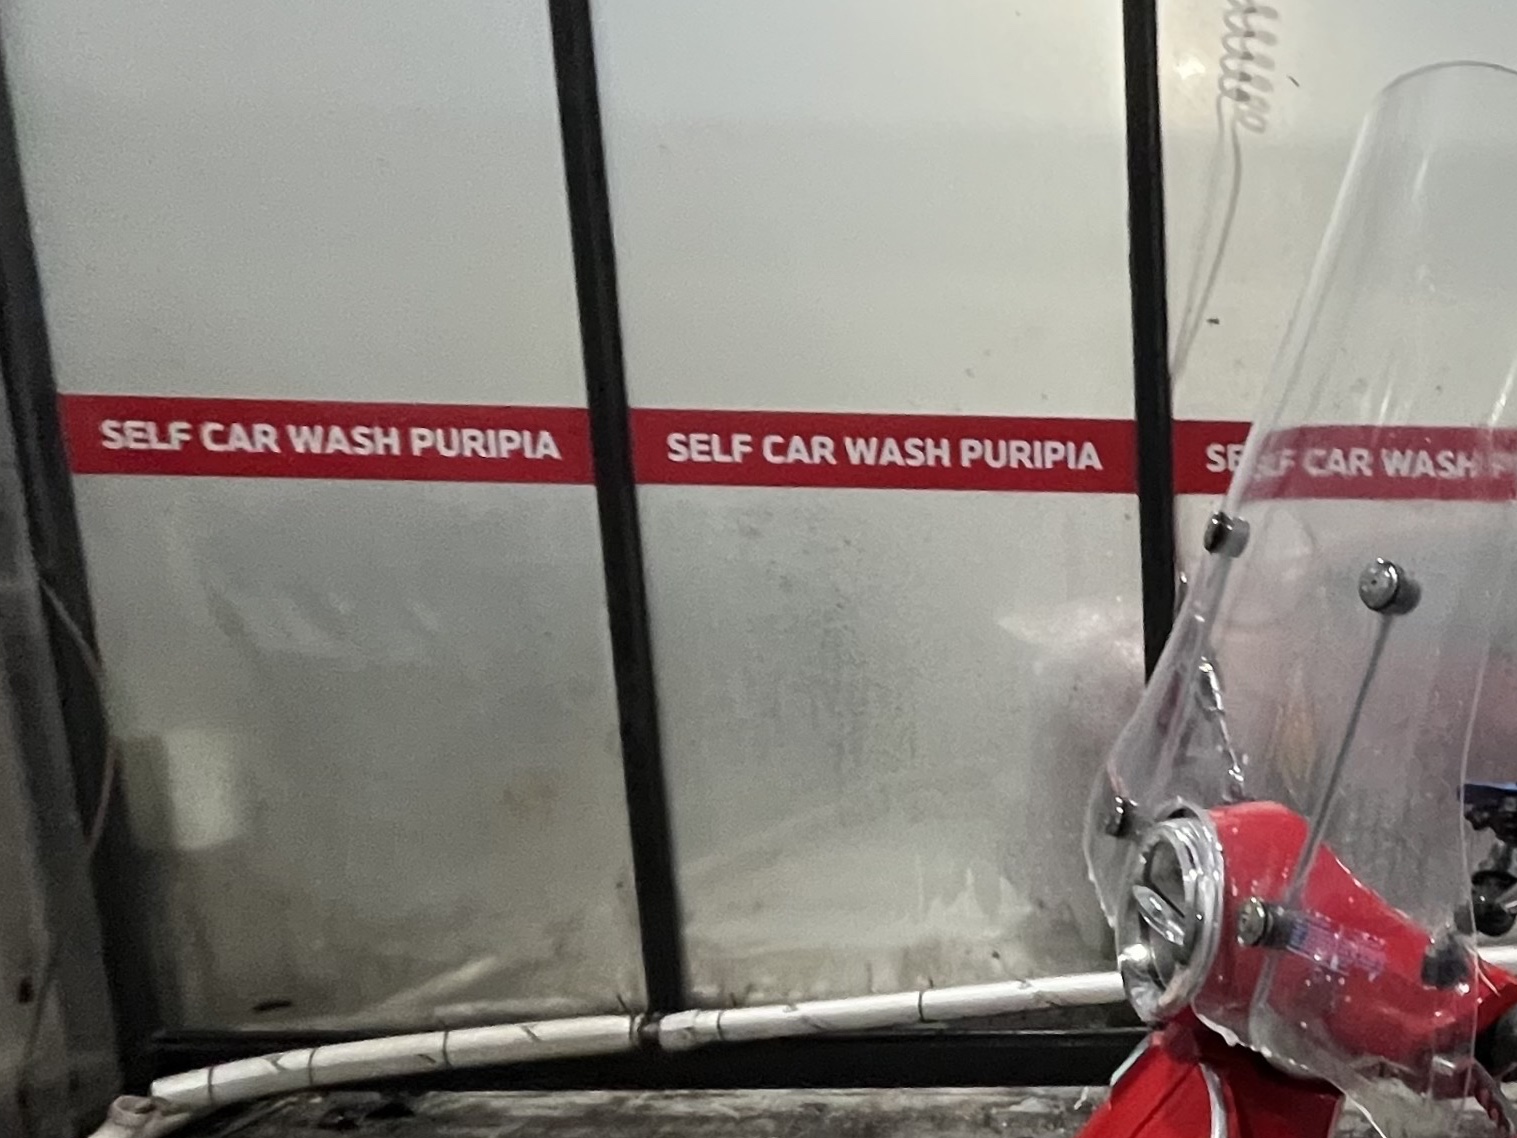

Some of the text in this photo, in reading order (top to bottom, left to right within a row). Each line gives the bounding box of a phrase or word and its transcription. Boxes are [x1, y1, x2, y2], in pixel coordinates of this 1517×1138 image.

[100, 419, 562, 461] SELF CAR WASH PURIPIA
[667, 432, 1103, 471] SELF CAR WASH PURIPIA
[1304, 448, 1373, 478] CAR
[1380, 449, 1478, 480] WASH
